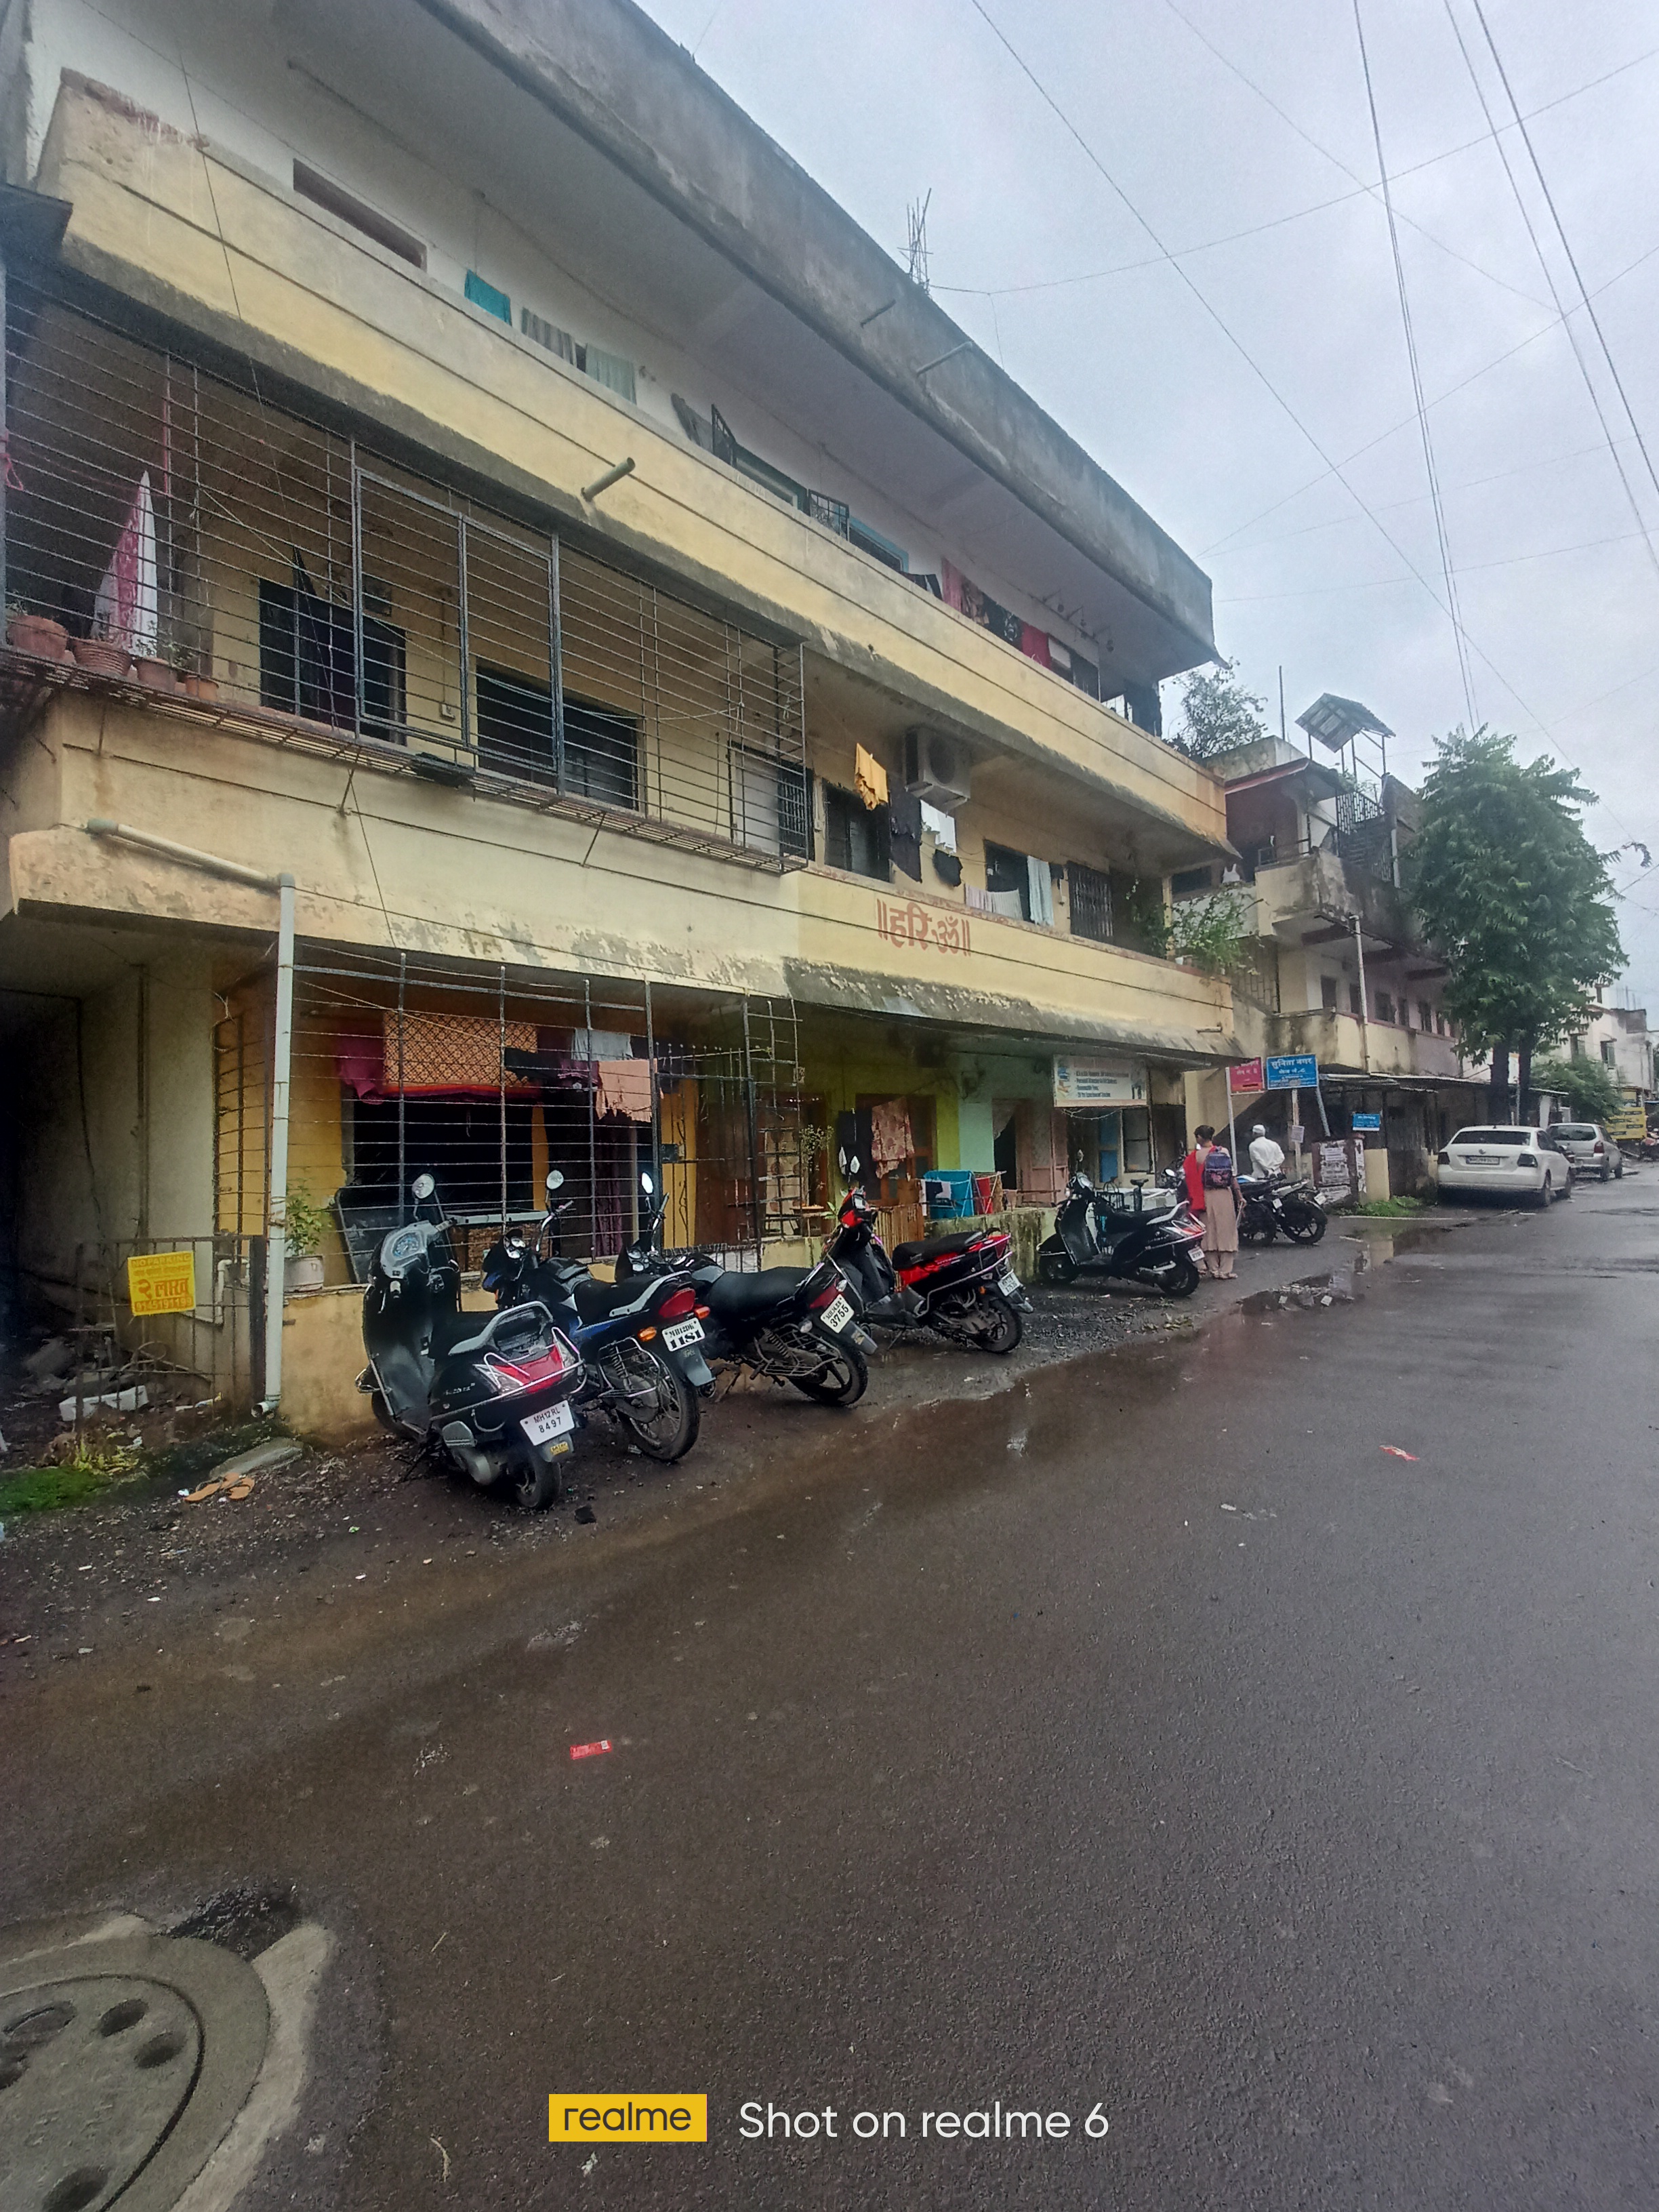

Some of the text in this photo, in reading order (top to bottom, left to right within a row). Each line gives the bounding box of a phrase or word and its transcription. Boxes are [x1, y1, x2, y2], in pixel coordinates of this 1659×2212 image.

[1271, 1059, 1295, 1069] सुनिता
[132, 1254, 191, 1267] NO PARKING
[830, 1304, 849, 1328] 3755
[670, 1329, 702, 1349] 1181
[533, 1407, 560, 1424] MH12RL
[538, 1416, 562, 1433] 8497
